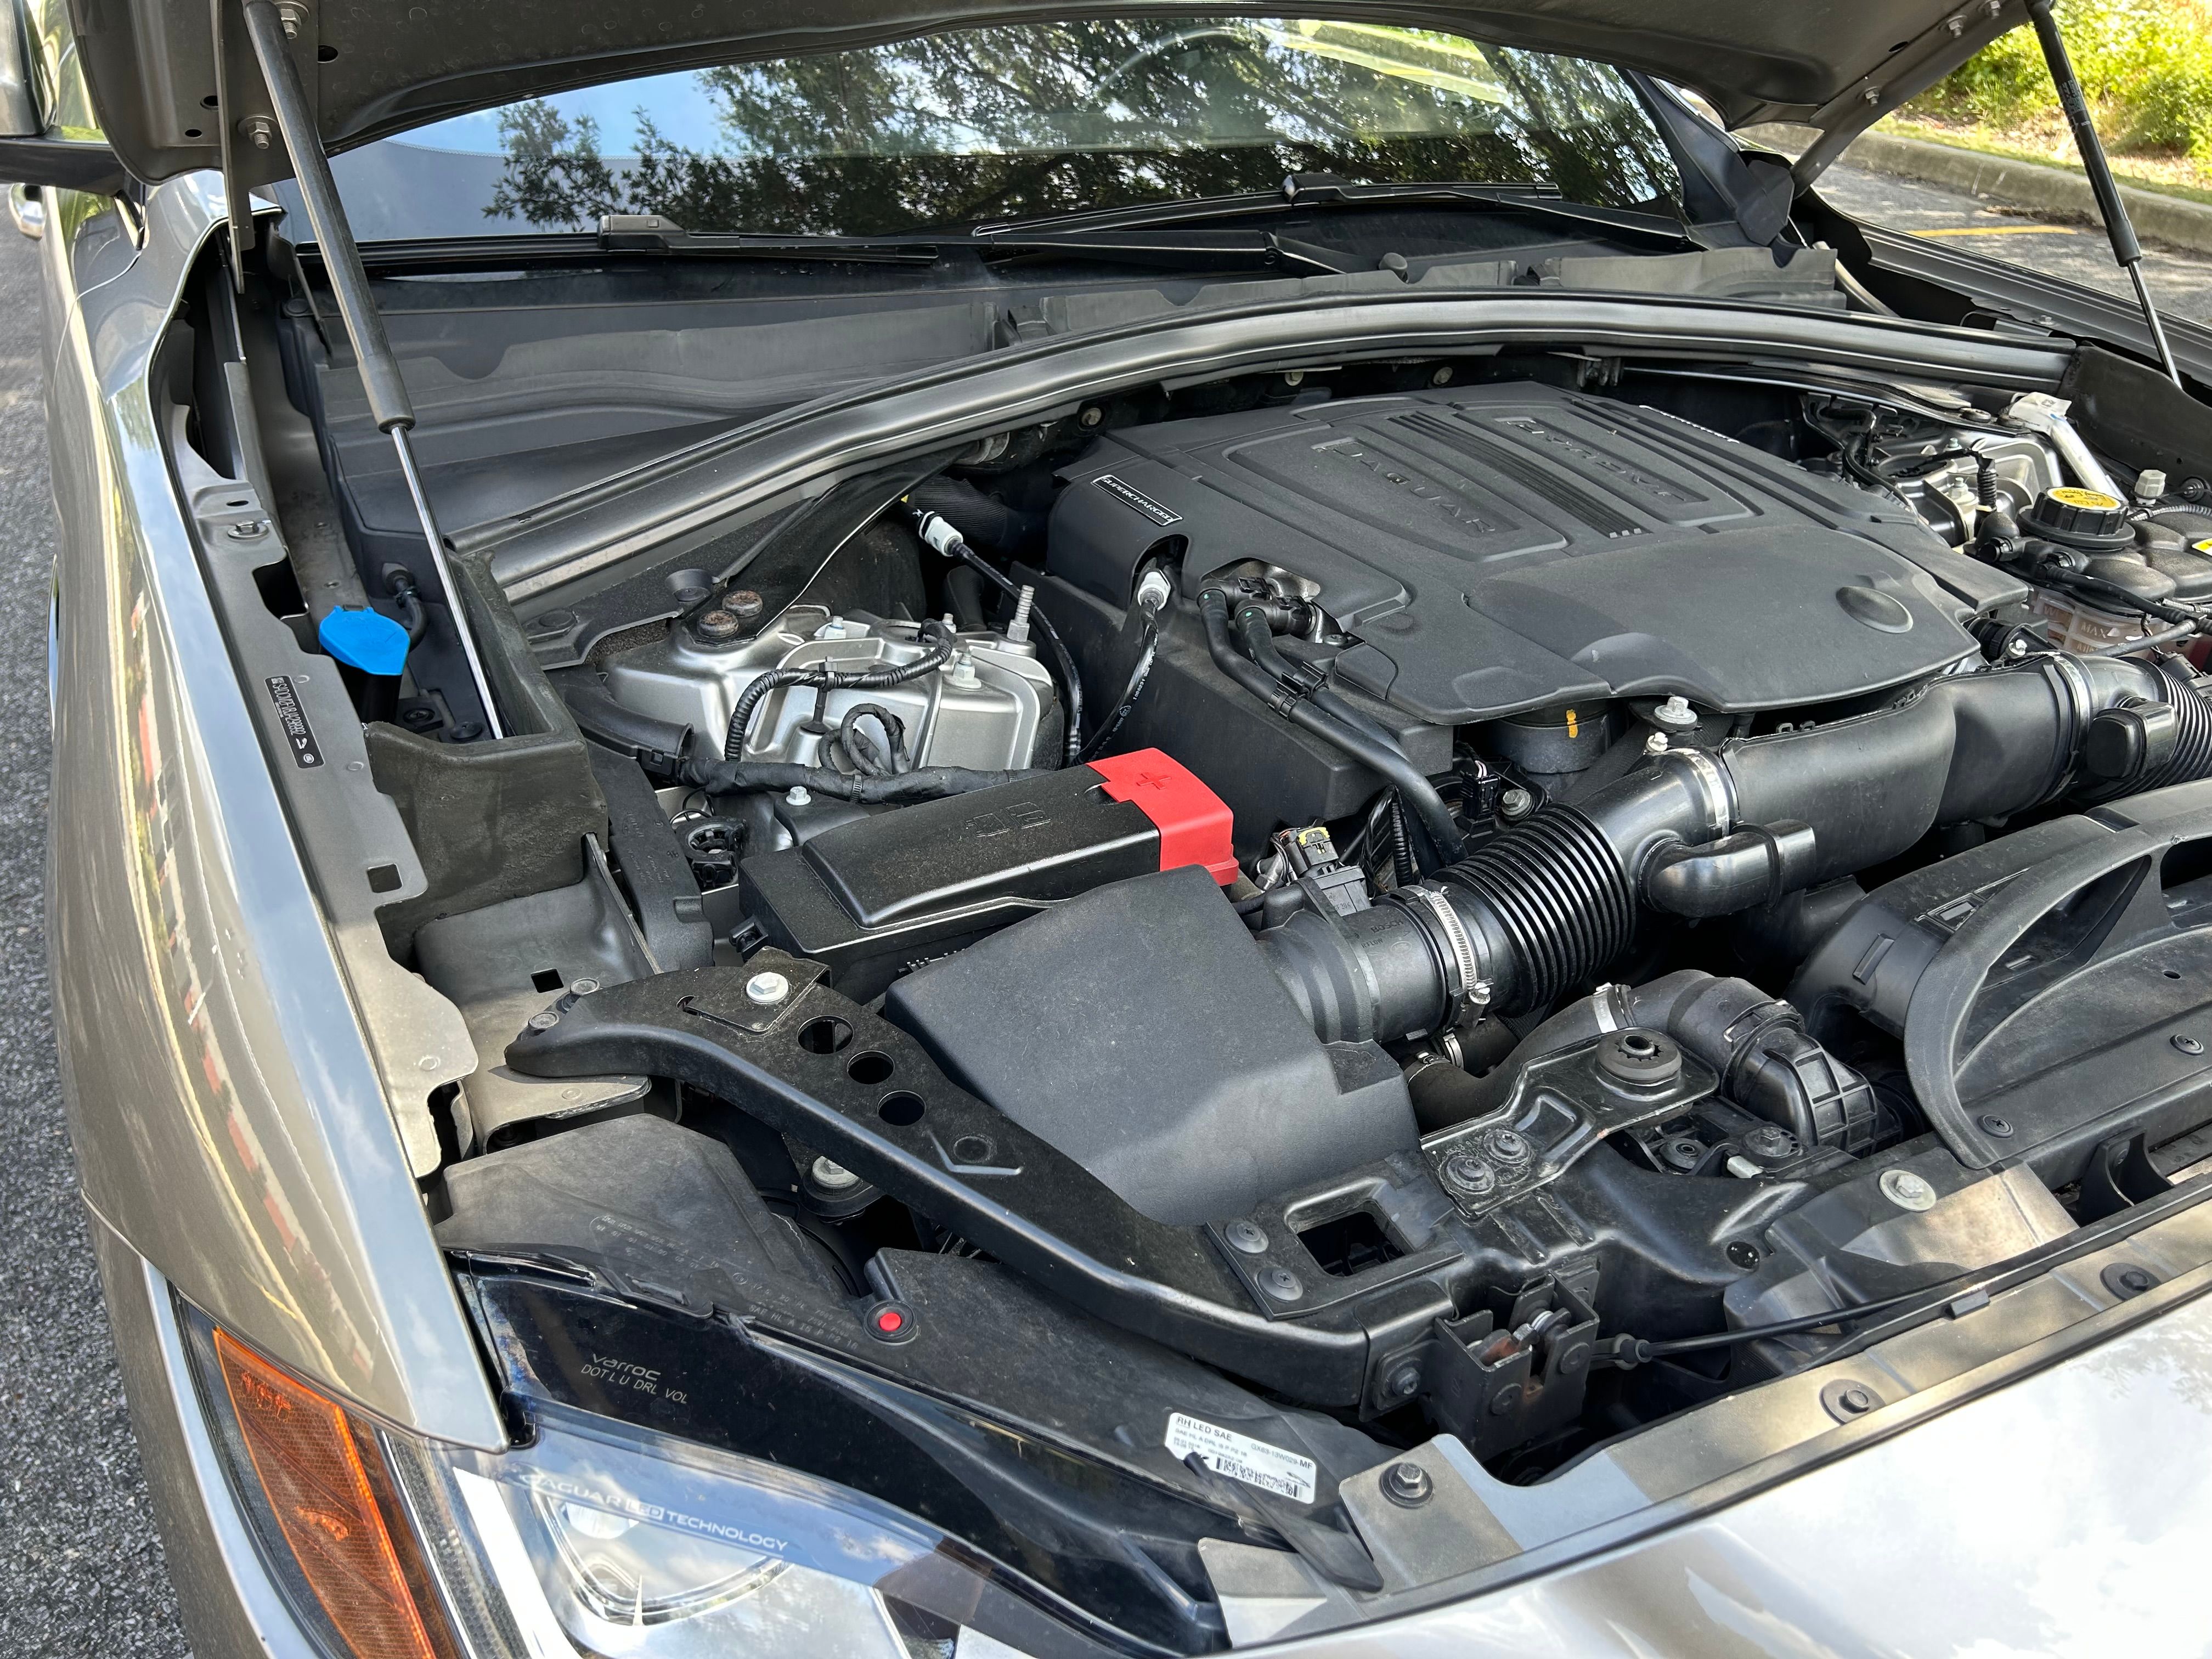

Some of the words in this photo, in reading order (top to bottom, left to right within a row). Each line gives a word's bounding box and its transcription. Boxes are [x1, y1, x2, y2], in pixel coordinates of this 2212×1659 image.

[1101, 477, 1174, 522] SUPERCHARGED
[1318, 445, 1496, 533] JAGUAR
[2081, 622, 2109, 639] MAX
[1370, 919, 1404, 933] BOSCH
[581, 1364, 610, 1379] DOT
[608, 1372, 615, 1382] L
[619, 1374, 630, 1385] U
[633, 1379, 657, 1395] DRL
[665, 1388, 687, 1404] VOL
[1177, 1417, 1191, 1427] RH
[1193, 1422, 1211, 1434] LED
[1214, 1429, 1232, 1442] SAE
[666, 1510, 789, 1552] TECHNOLOGY
